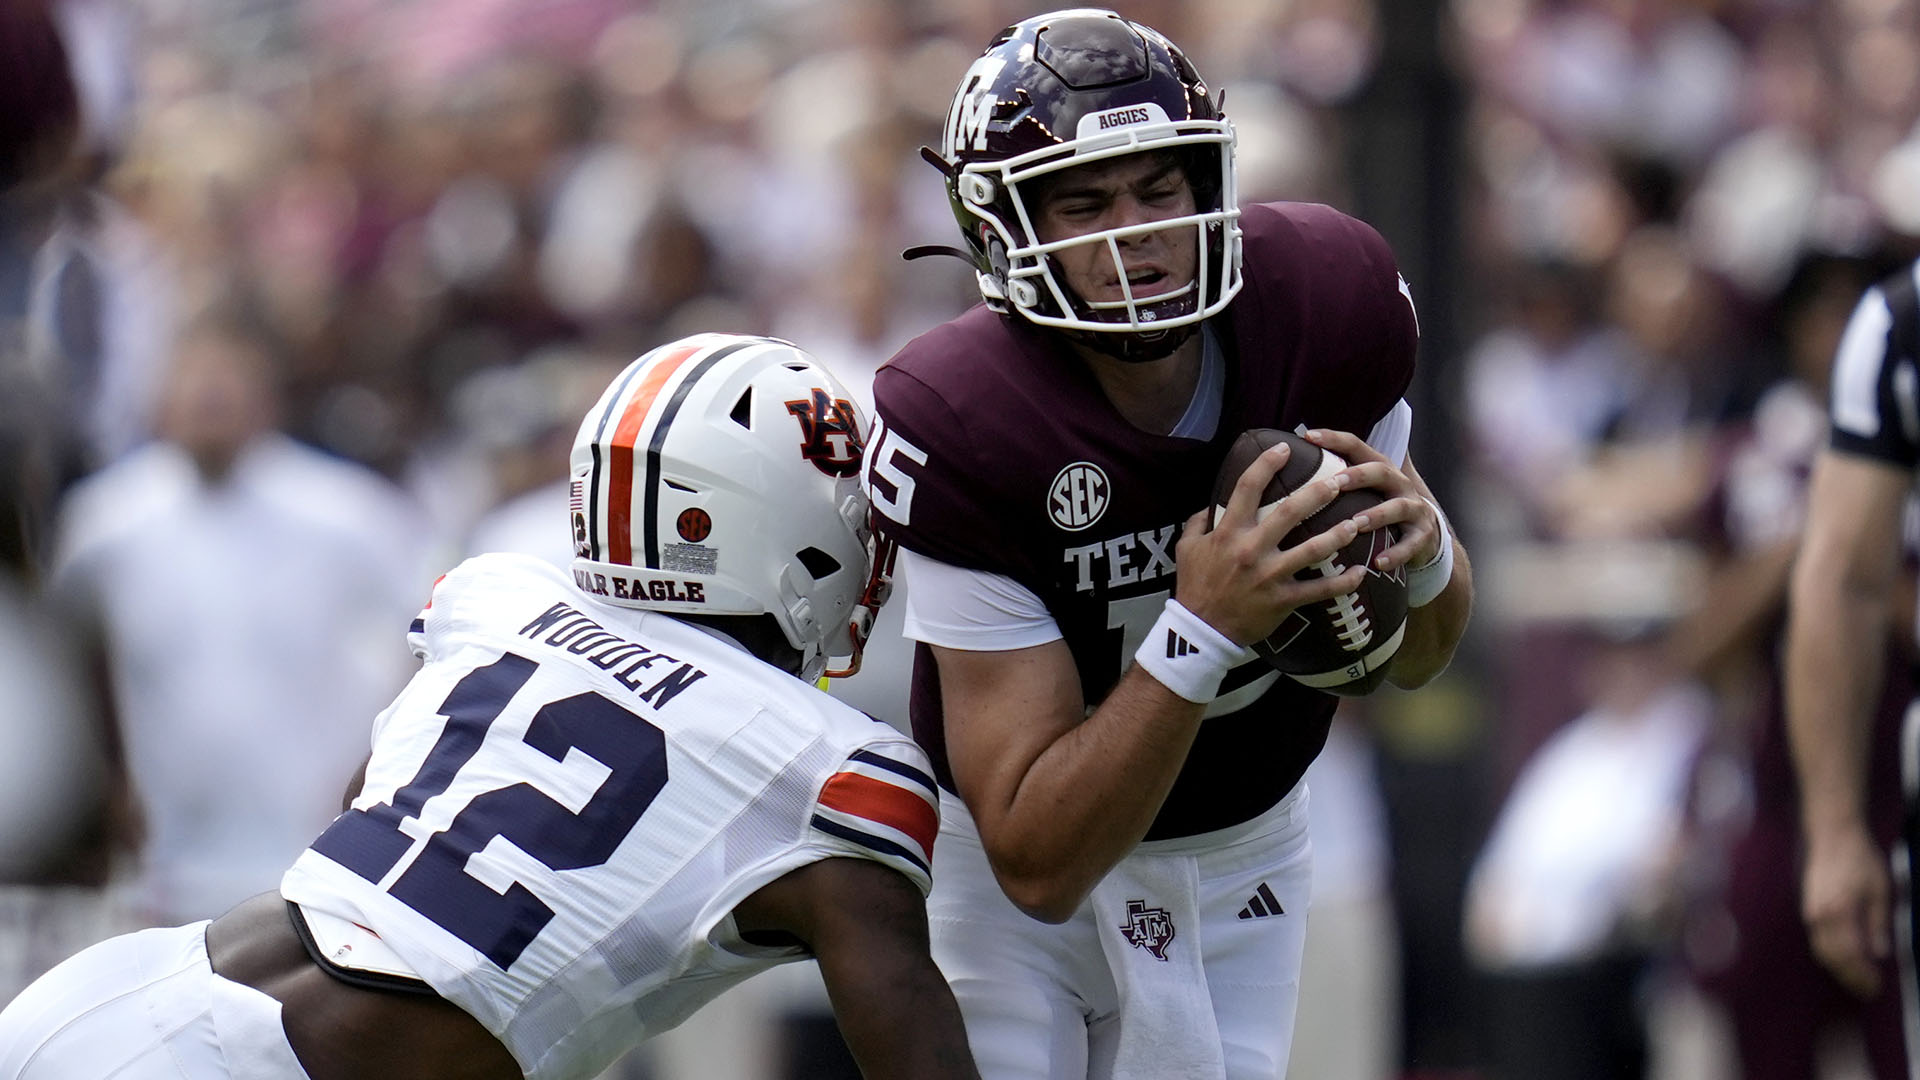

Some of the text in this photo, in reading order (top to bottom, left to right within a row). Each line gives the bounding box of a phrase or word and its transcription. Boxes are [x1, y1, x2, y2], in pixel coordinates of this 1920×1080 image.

[1098, 107, 1149, 130] AGGIES
[861, 411, 929, 526] 15
[1051, 465, 1106, 527] SEC
[573, 569, 706, 603] WAR EAGLE
[1064, 522, 1177, 592] TEX
[518, 602, 708, 711] WOODEN
[309, 651, 669, 972] 12
